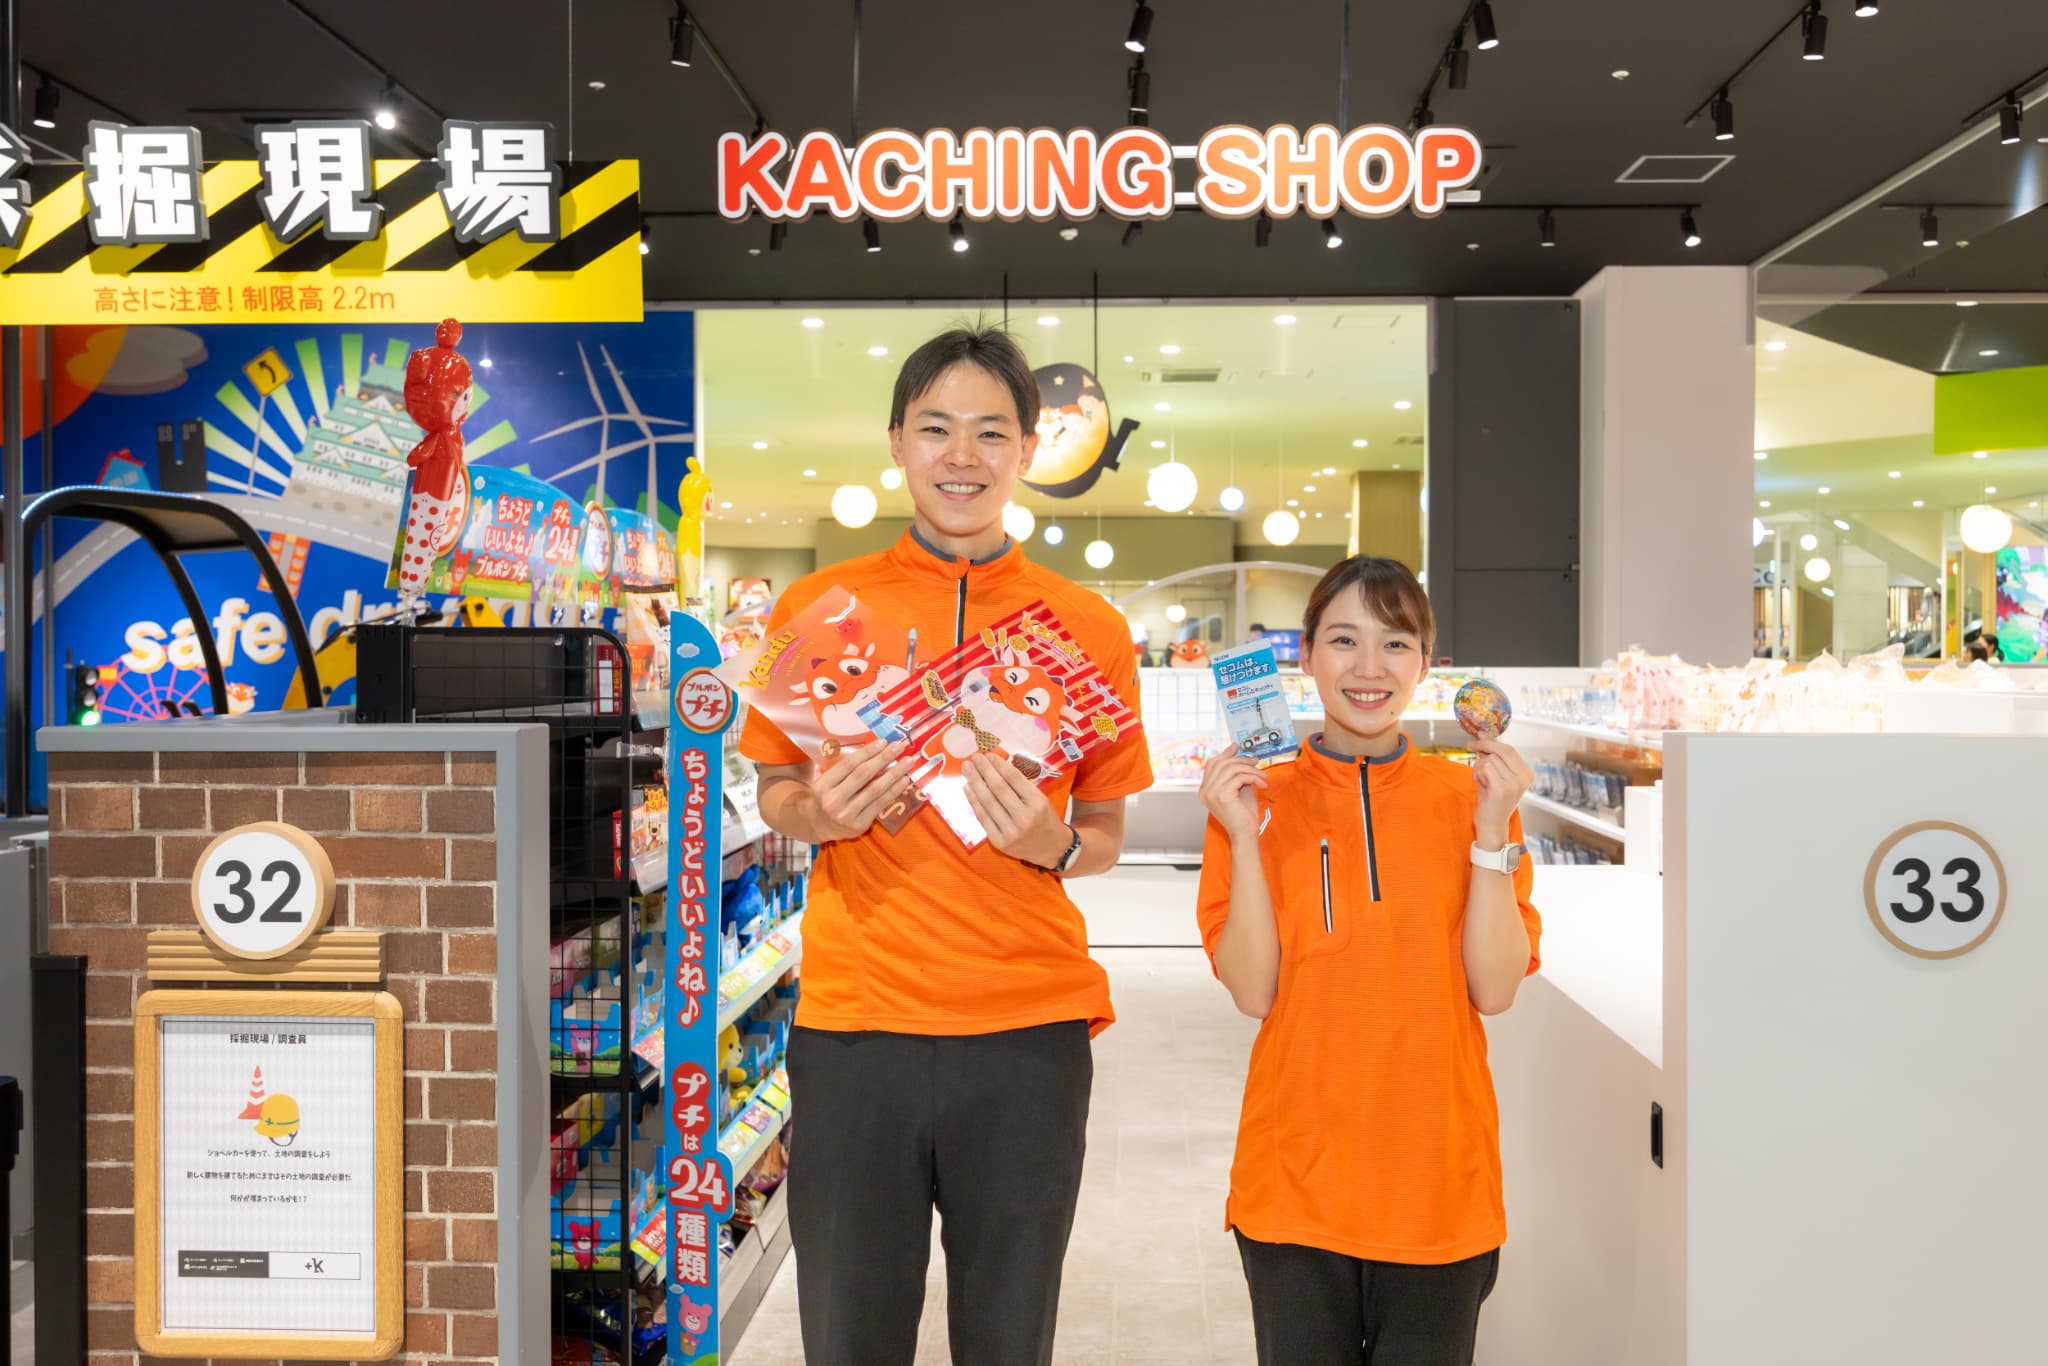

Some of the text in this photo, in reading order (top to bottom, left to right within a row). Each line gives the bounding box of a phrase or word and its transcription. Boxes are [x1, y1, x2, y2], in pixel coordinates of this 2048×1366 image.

[717, 127, 1483, 218] KACHING SHOP
[332, 285, 396, 310] 2.2m
[499, 495, 533, 526] ちょうど
[476, 555, 511, 577] ブルボン
[121, 598, 287, 674] safe
[738, 630, 797, 691] Kandu
[686, 682, 722, 692] ブルボン
[685, 694, 725, 719] プチ
[213, 859, 303, 924] 32
[1890, 857, 1985, 923] 33
[230, 1033, 269, 1044] 採掘現場
[278, 1033, 307, 1045] 調査員
